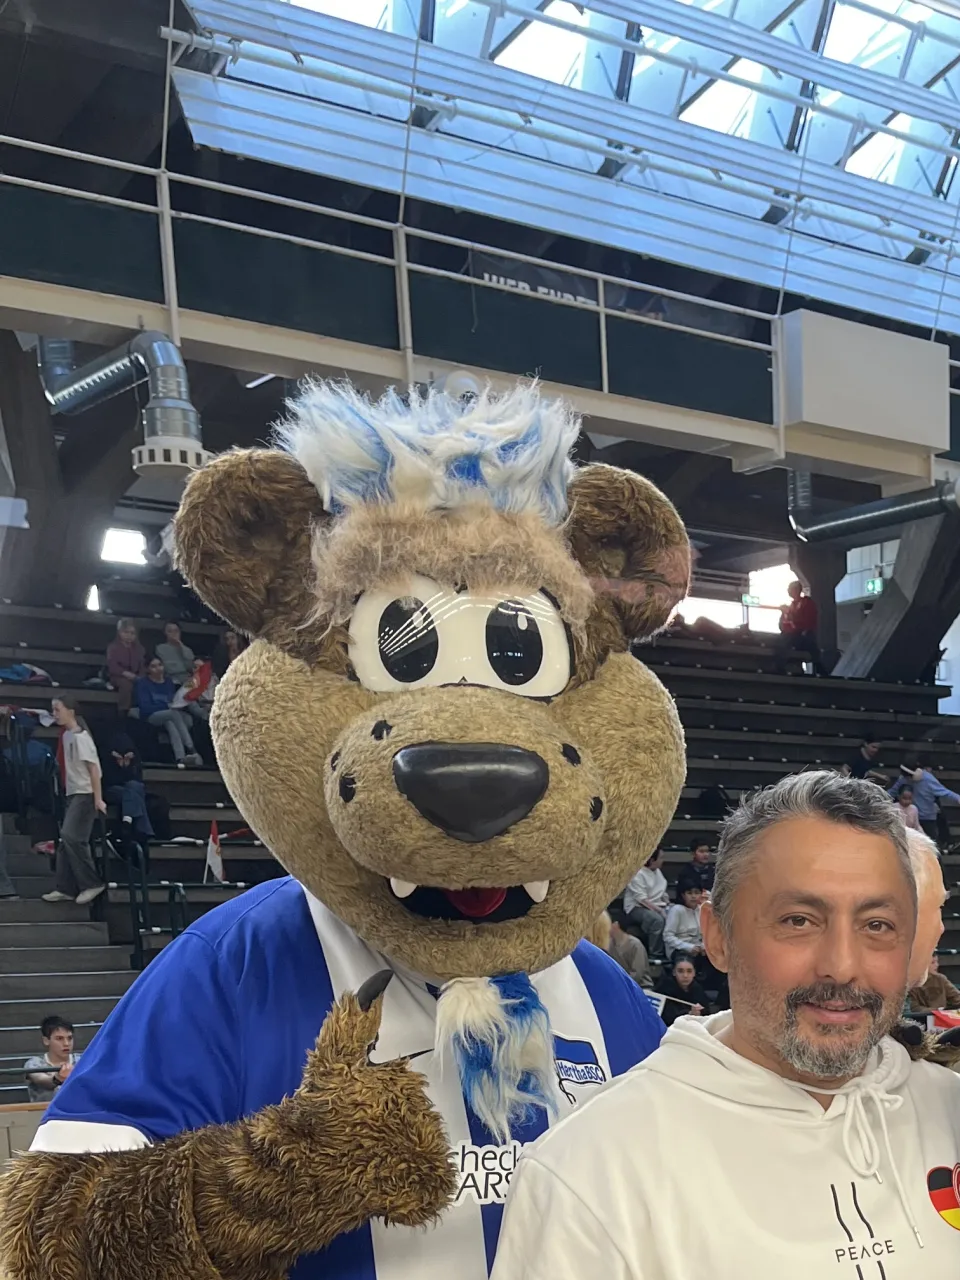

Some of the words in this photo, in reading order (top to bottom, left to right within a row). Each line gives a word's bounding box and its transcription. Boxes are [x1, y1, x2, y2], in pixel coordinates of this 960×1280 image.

[536, 285, 598, 306] END
[450, 1144, 520, 1173] heck
[834, 1239, 896, 1263] PEACE
